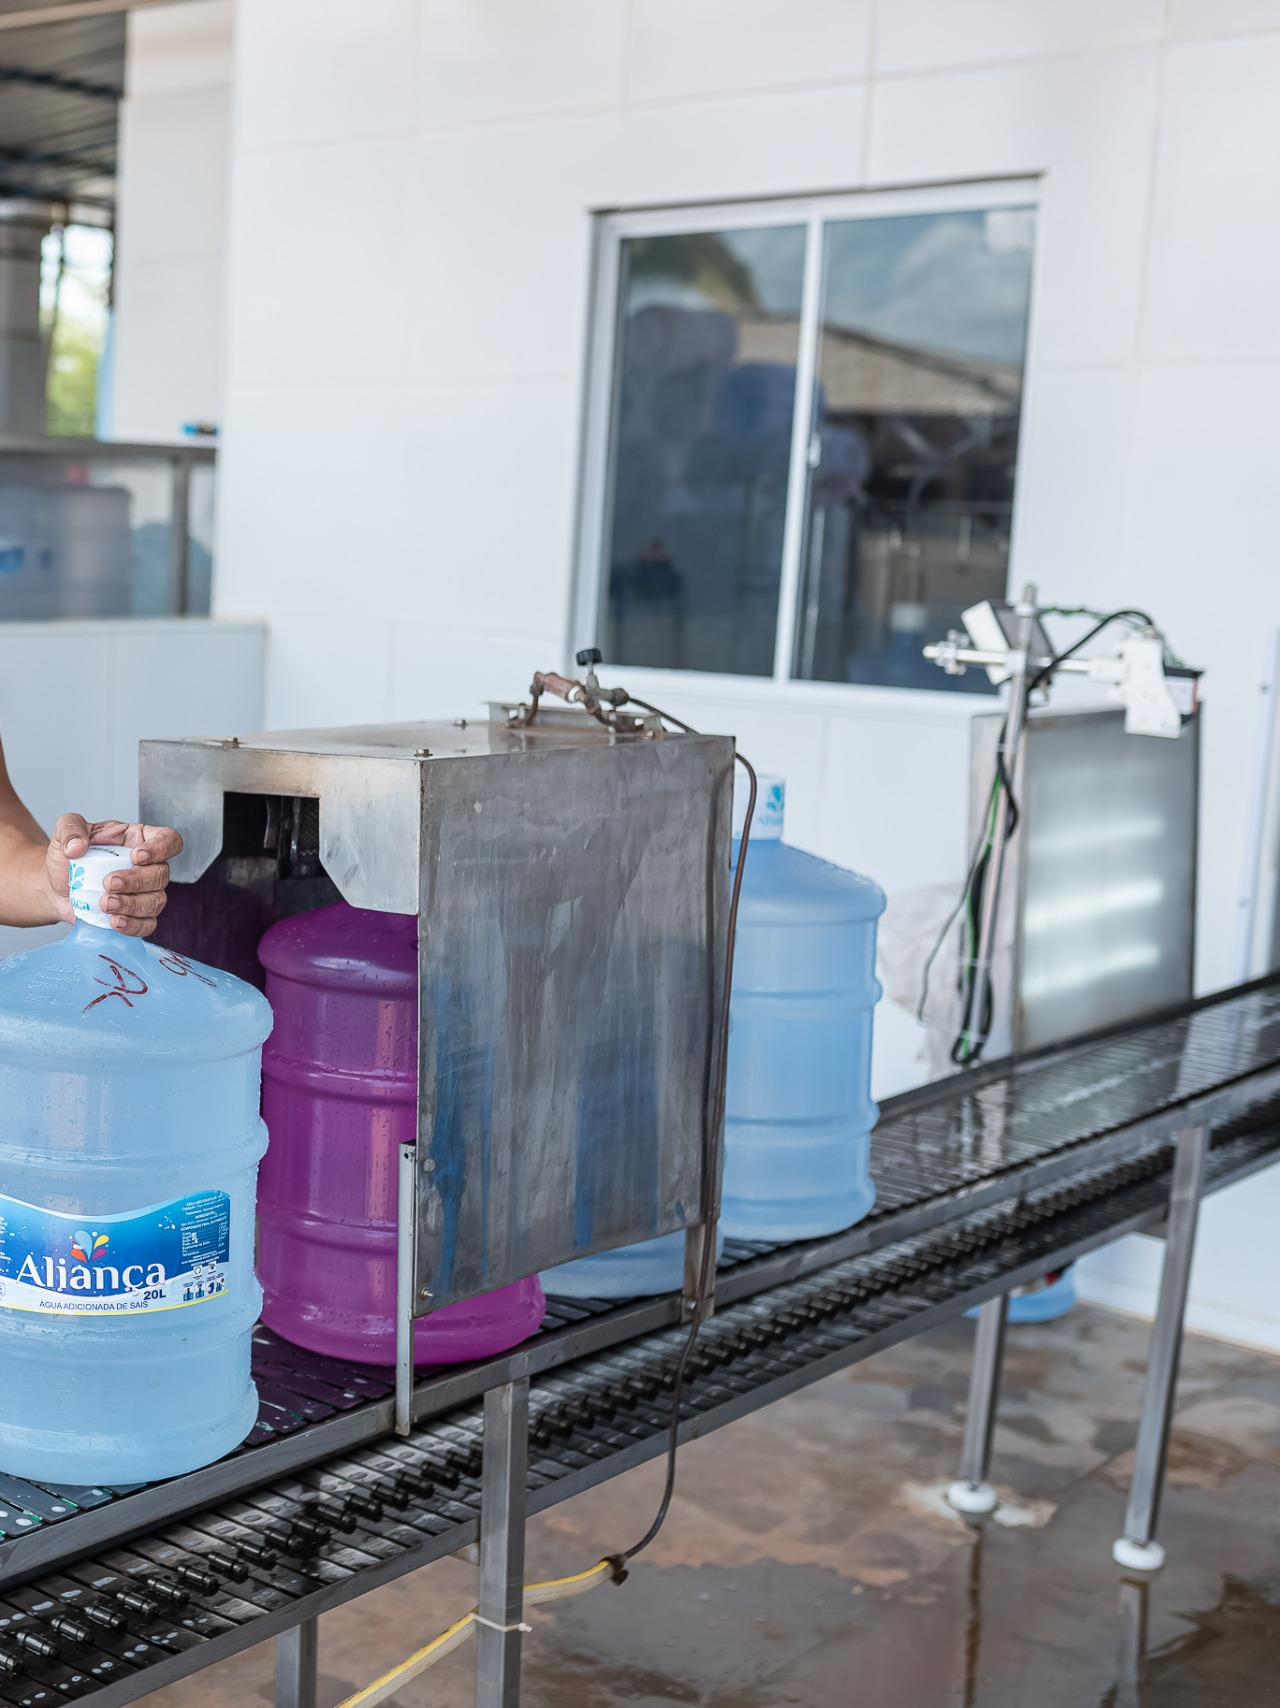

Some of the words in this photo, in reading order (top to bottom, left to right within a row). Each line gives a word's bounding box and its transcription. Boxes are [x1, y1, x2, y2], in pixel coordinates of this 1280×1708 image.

[16, 1254, 166, 1296] Aliança
[143, 1289, 166, 1301] 20L
[39, 1299, 62, 1310] ÁGUA
[63, 1302, 115, 1311] ADICIONADA
[116, 1302, 128, 1310] DE
[129, 1300, 149, 1309] SAIS
